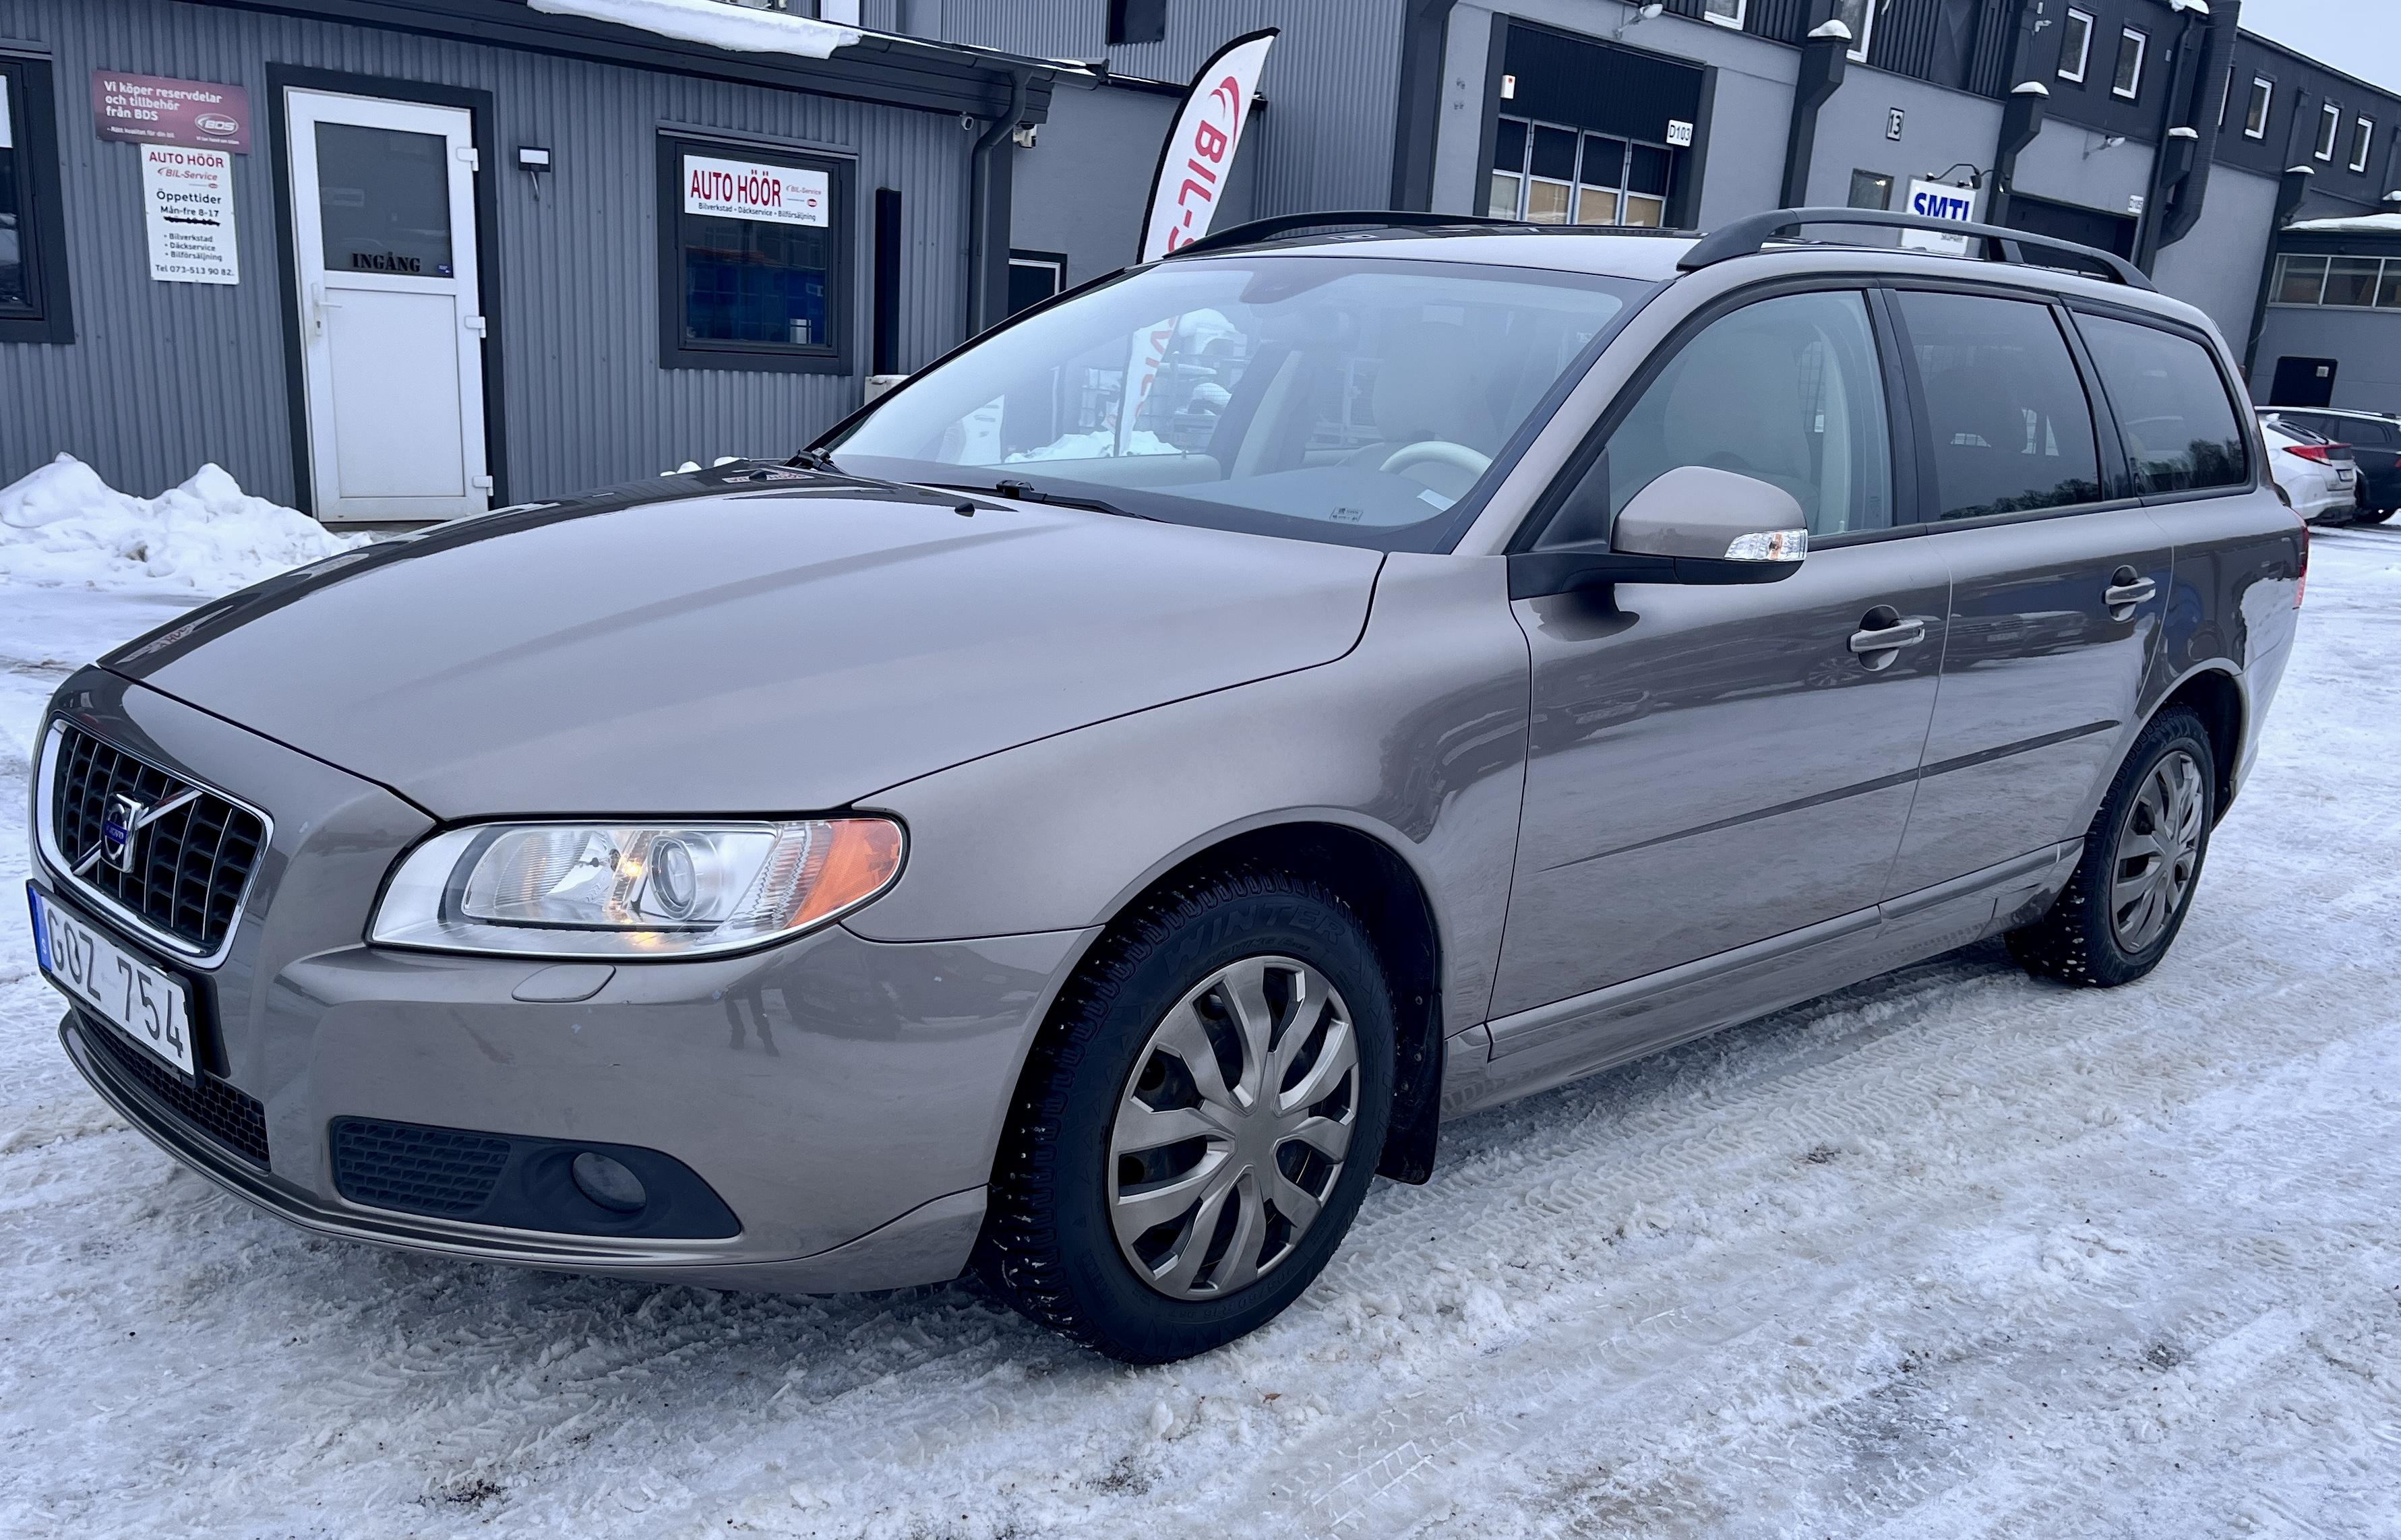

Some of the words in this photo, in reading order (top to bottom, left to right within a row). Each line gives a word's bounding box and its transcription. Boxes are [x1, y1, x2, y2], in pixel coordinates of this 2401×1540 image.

[104, 80, 117, 92] Vi
[119, 82, 154, 96] köper
[156, 88, 222, 103] reservdelar
[105, 94, 127, 105] och
[129, 96, 180, 111] tillbehör
[106, 105, 131, 118] från
[133, 109, 158, 121] BDS
[204, 119, 236, 131] BDS
[1889, 114, 1902, 135] 13
[149, 151, 184, 164] AUTO
[187, 153, 224, 168] HÖÖR
[166, 168, 218, 181] BIL-Service
[156, 188, 221, 204] Öppettider
[690, 170, 733, 202] AUTO
[737, 169, 781, 207] HÖÖR
[160, 206, 196, 216] Mån-fre
[198, 208, 219, 217] 8-17
[698, 203, 733, 212] Bilverkstad
[738, 206, 772, 216] Däckservice
[778, 210, 816, 222] Bilförsäljning
[169, 233, 214, 243] Bilverkstad
[170, 242, 216, 251] Däckservice
[171, 251, 222, 262] Bilförsäljning
[352, 251, 421, 272] INGÅNG
[156, 264, 168, 272] Tel
[1163, 903, 1346, 977] WINTER
[47, 908, 101, 1002] GOZ
[116, 955, 184, 1059] 754
